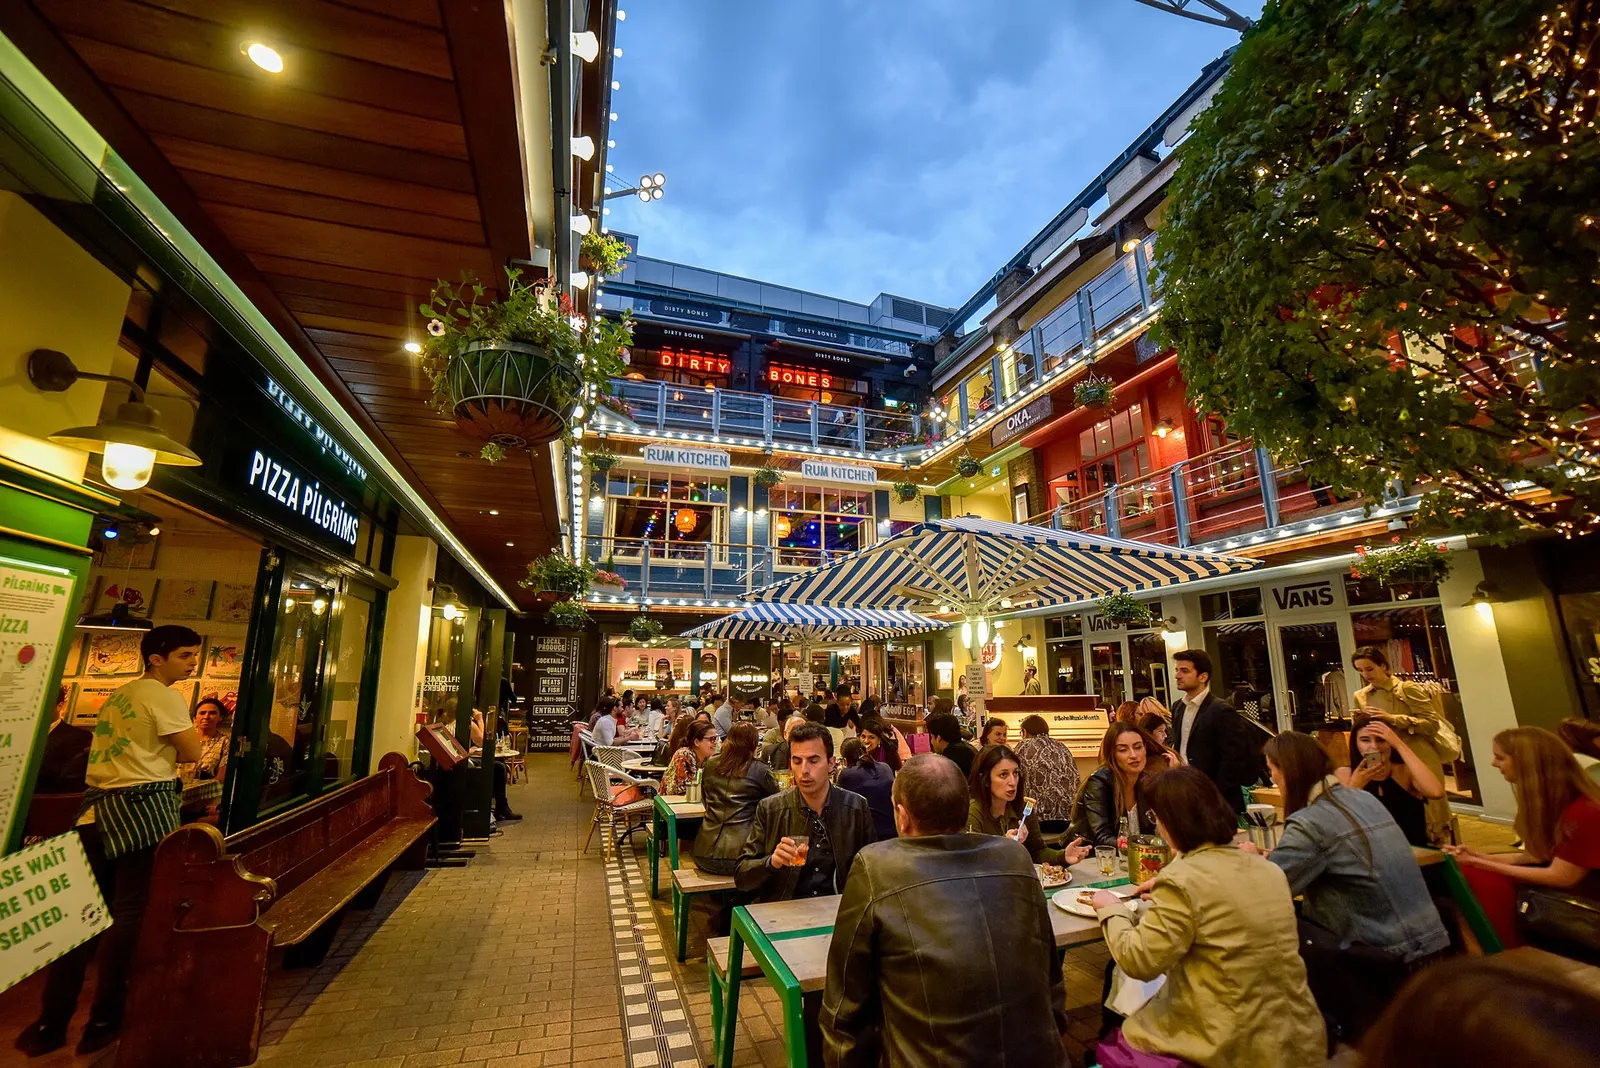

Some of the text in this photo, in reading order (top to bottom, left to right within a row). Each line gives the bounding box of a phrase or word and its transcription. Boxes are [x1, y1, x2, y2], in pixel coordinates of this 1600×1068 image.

[664, 305, 709, 317] DIRTY BONES
[664, 329, 704, 340] DIRTY BONES
[797, 327, 837, 339] DIRTY BONES
[662, 355, 728, 373] DIRTY
[815, 352, 850, 363] DIRTY BONES
[770, 370, 830, 388] BONES
[647, 448, 728, 467] RUM KITCHEN
[249, 449, 300, 511] PIZZA
[804, 463, 875, 483] RUM KITCHEN
[1271, 580, 1334, 610] VANS
[902, 705, 916, 716] EGG
[23, 884, 47, 906] TO
[49, 872, 71, 895] BE
